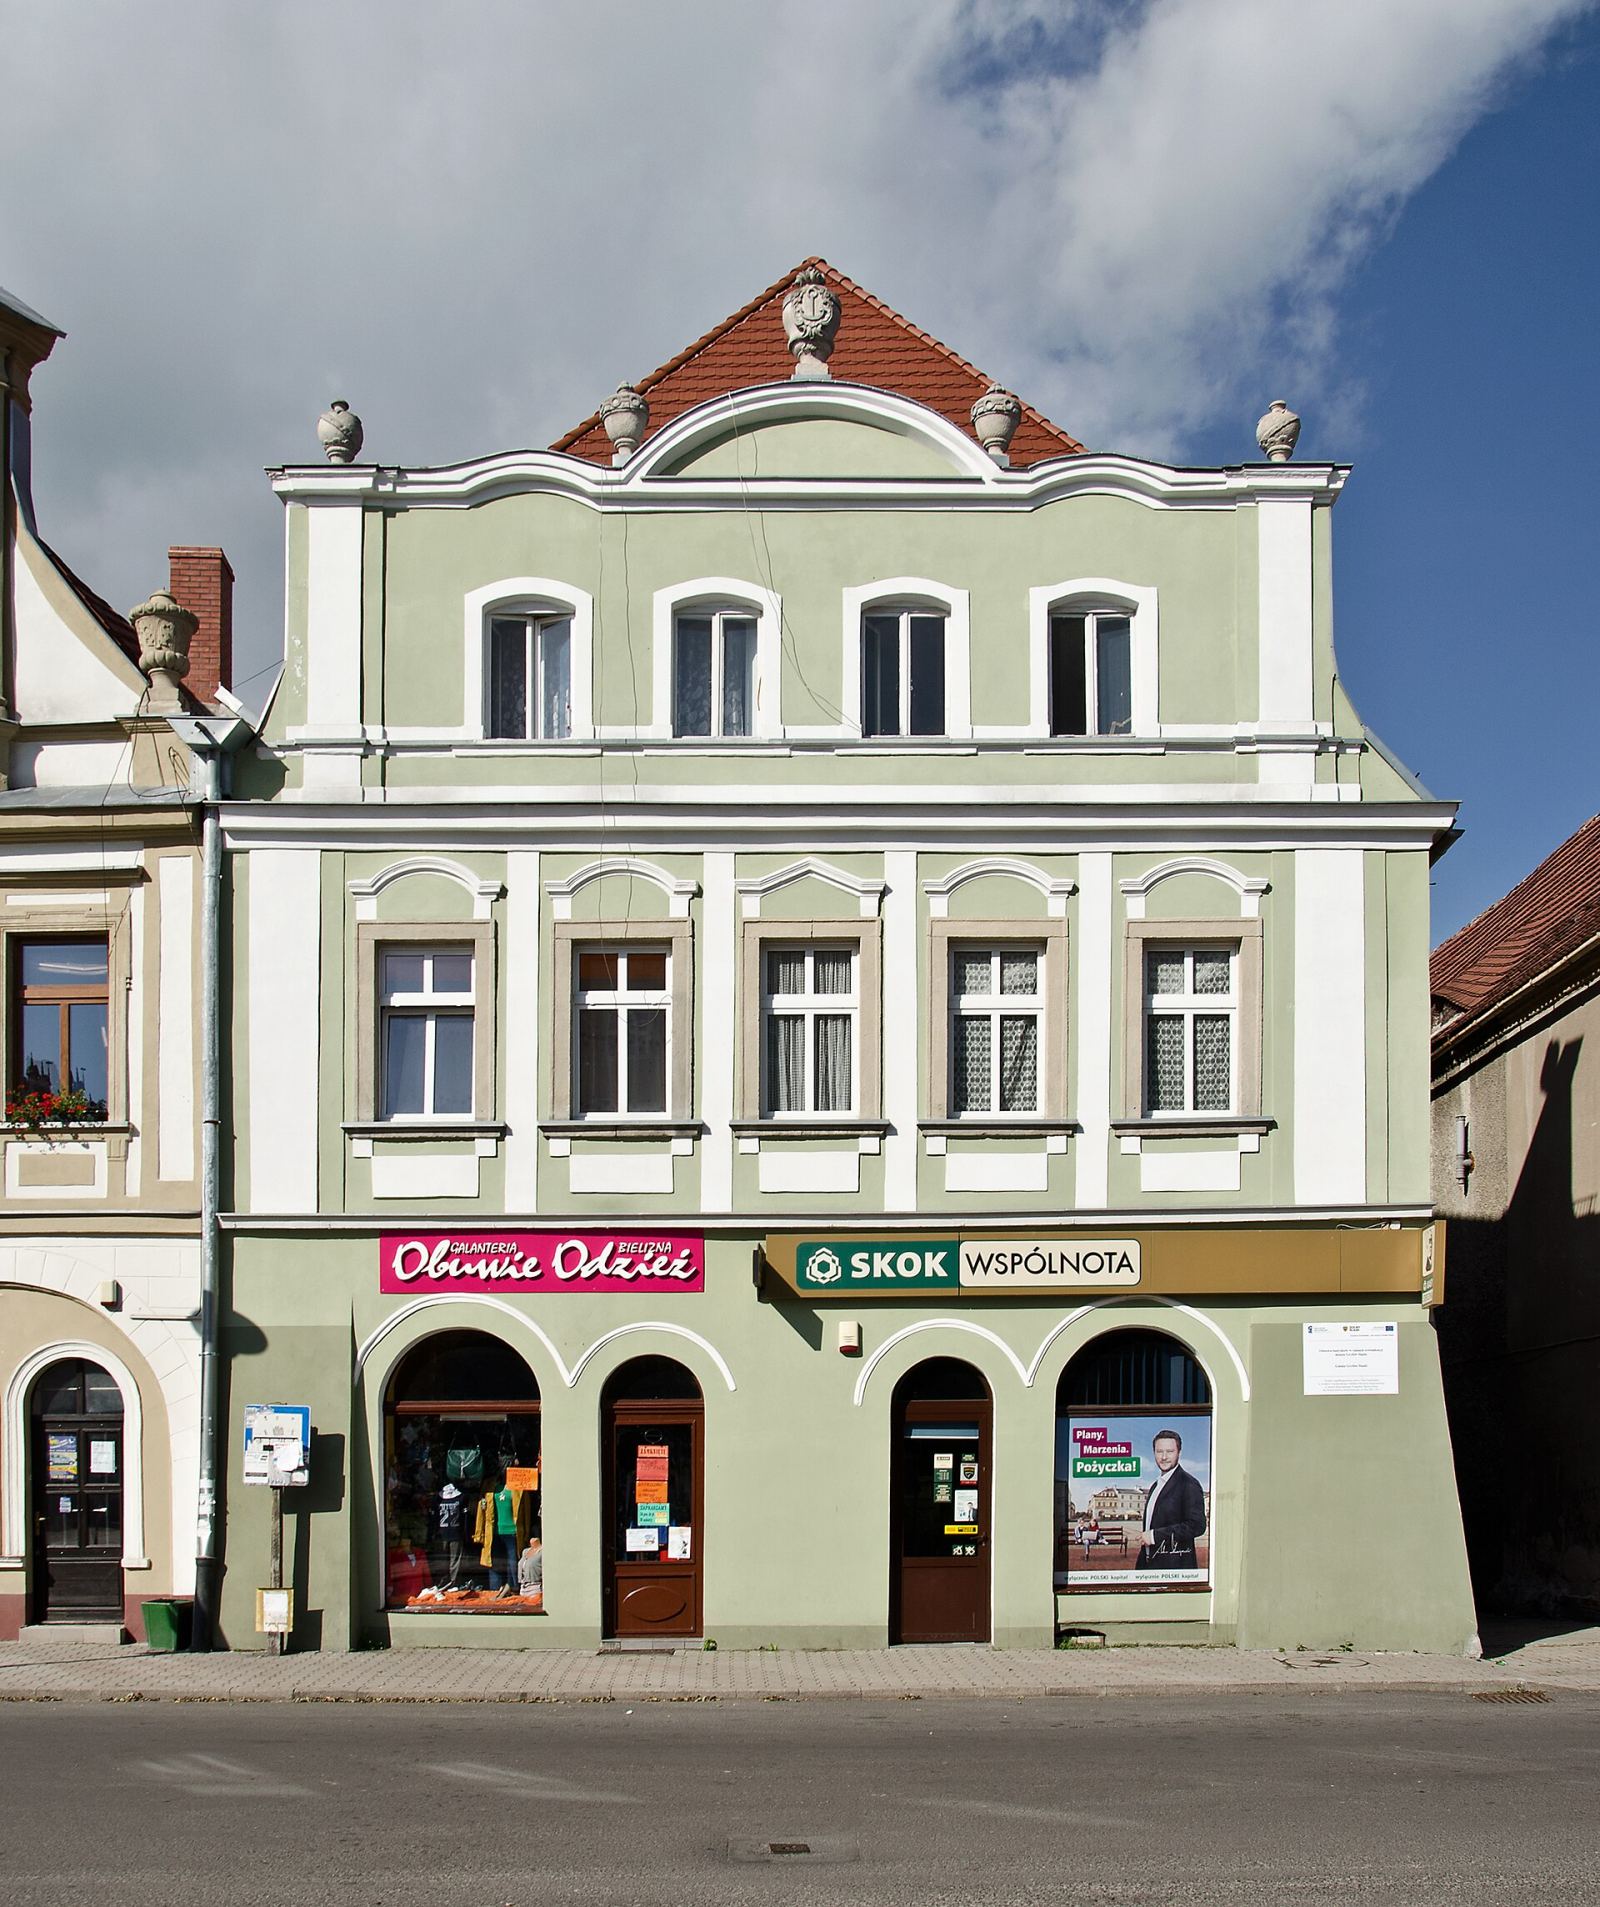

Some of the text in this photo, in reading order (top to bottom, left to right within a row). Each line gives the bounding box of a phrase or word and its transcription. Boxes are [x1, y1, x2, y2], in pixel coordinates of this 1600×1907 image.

[450, 1241, 517, 1254] GALANTERIA
[617, 1241, 672, 1254] BIELIZNA
[392, 1239, 697, 1280] Obuwie Odzież
[851, 1251, 948, 1278] SKOK
[965, 1246, 1135, 1276] WSPÓLNOTA
[1076, 1430, 1105, 1441] Plany.
[1083, 1444, 1129, 1454] Marzenia.
[1076, 1460, 1137, 1475] Pożyczka!
